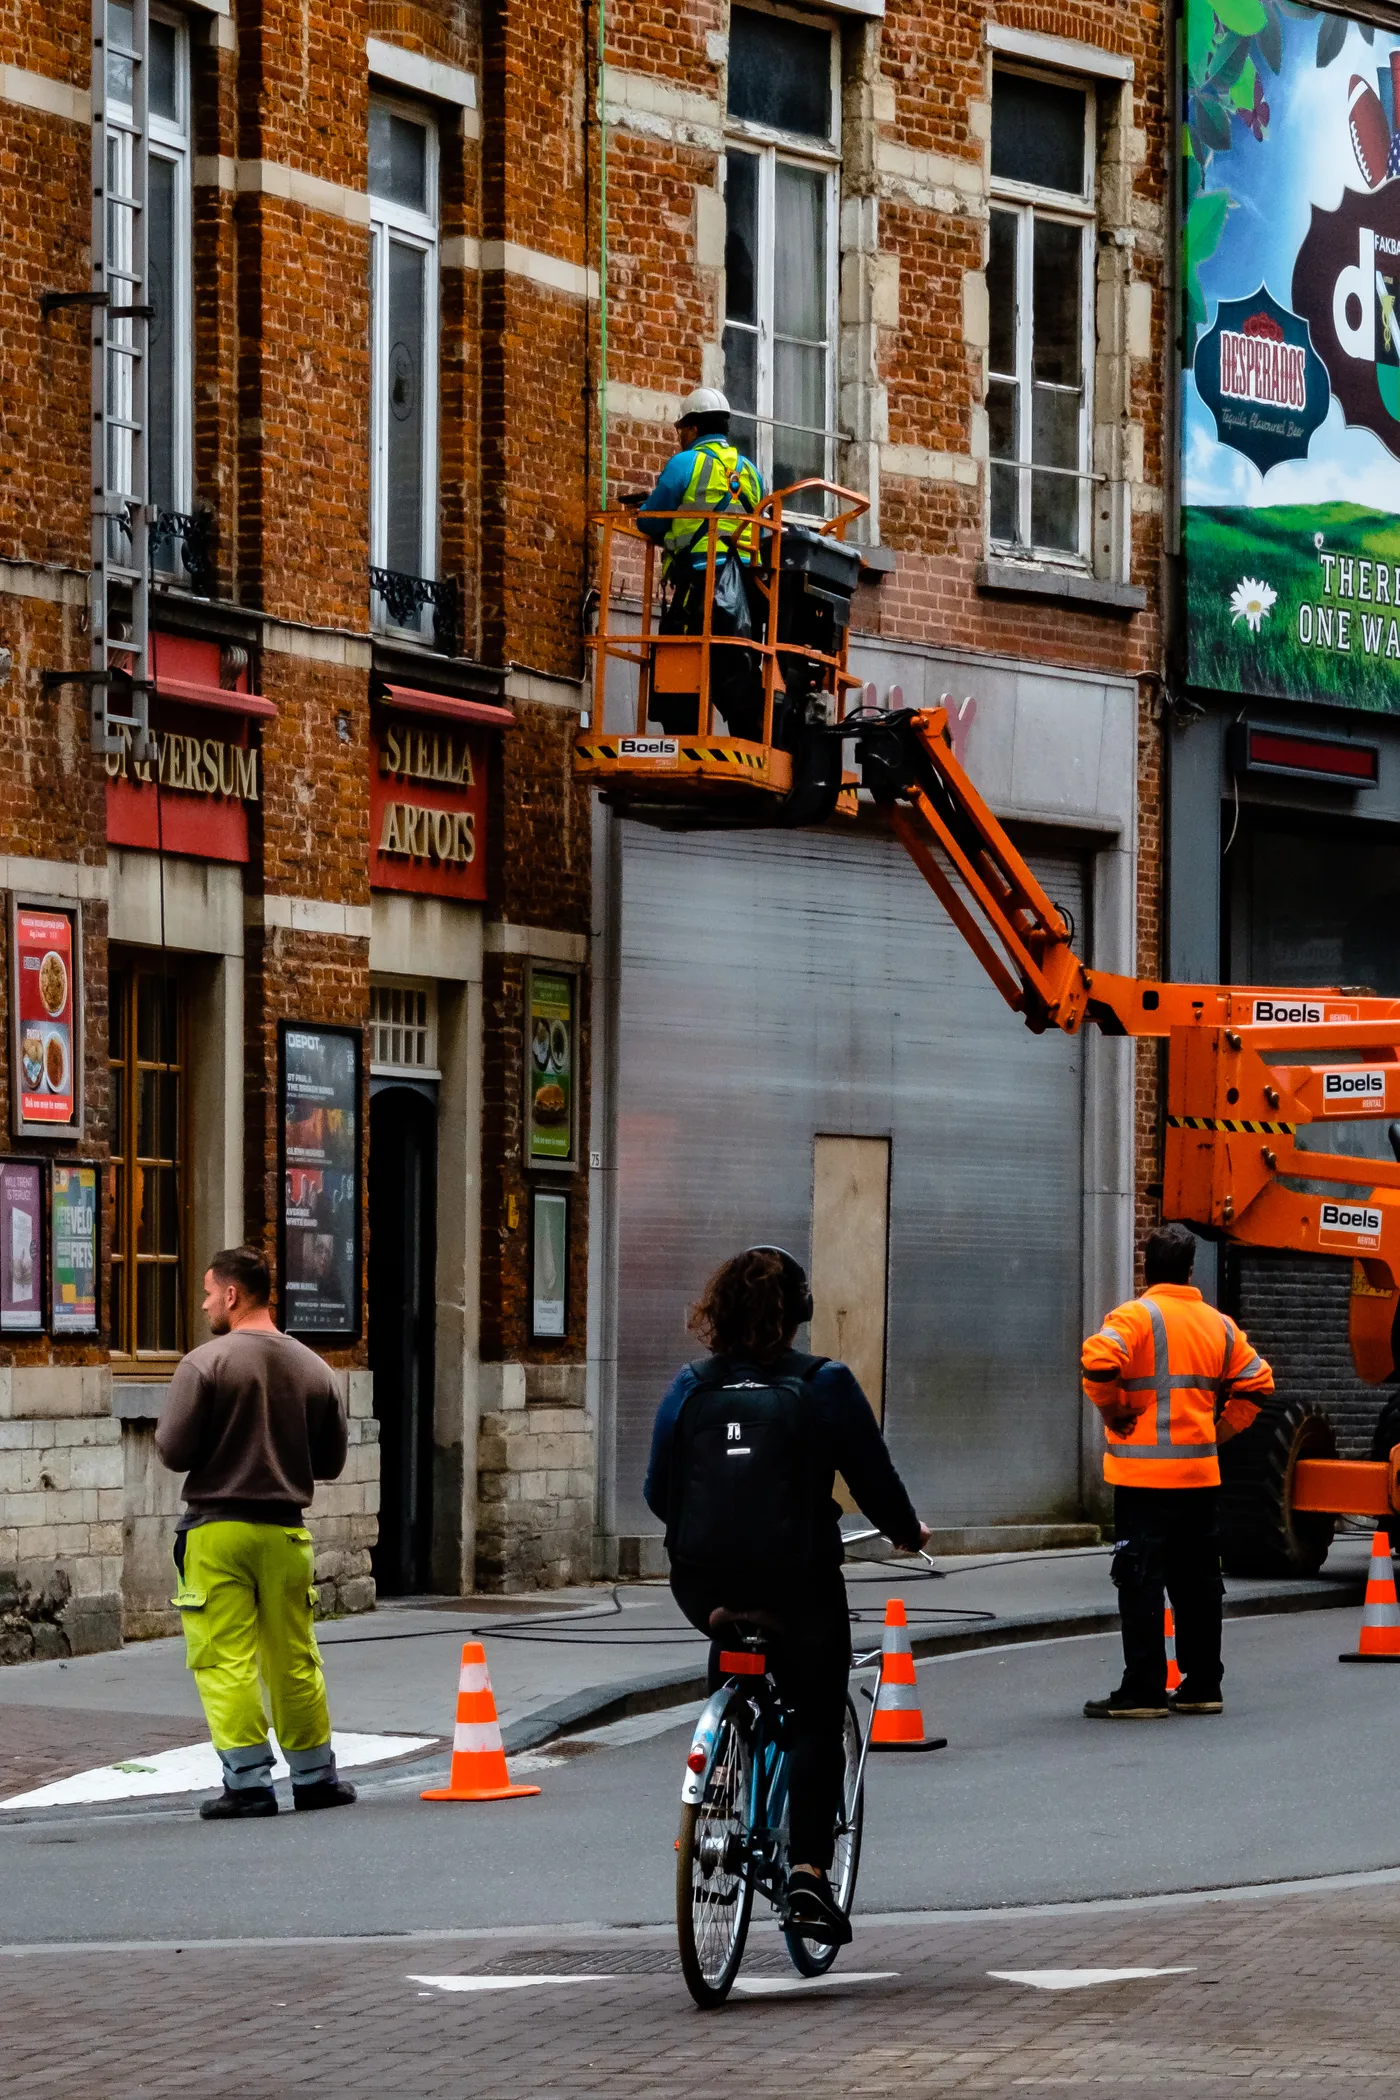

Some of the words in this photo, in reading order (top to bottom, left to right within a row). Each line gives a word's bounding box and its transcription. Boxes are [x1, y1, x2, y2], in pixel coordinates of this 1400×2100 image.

[1221, 333, 1304, 408] DESPERADOS
[1222, 408, 1248, 430] Tequila
[1286, 421, 1305, 438] Beer
[1299, 604, 1351, 650] ONE
[1361, 614, 1400, 658] WA
[381, 725, 476, 786] STELLA
[621, 740, 676, 753] Boels
[378, 800, 476, 864] ARTOIS
[1256, 1001, 1321, 1024] Boels
[287, 1033, 320, 1051] DEPOT
[1326, 1073, 1383, 1092] Boels
[1362, 1099, 1383, 1108] RENTAL
[592, 1154, 600, 1166] 75
[71, 1206, 93, 1235] VELO
[1322, 1205, 1379, 1229] Boels
[1357, 1235, 1378, 1247] RENTAL
[71, 1241, 94, 1268] FIETS
